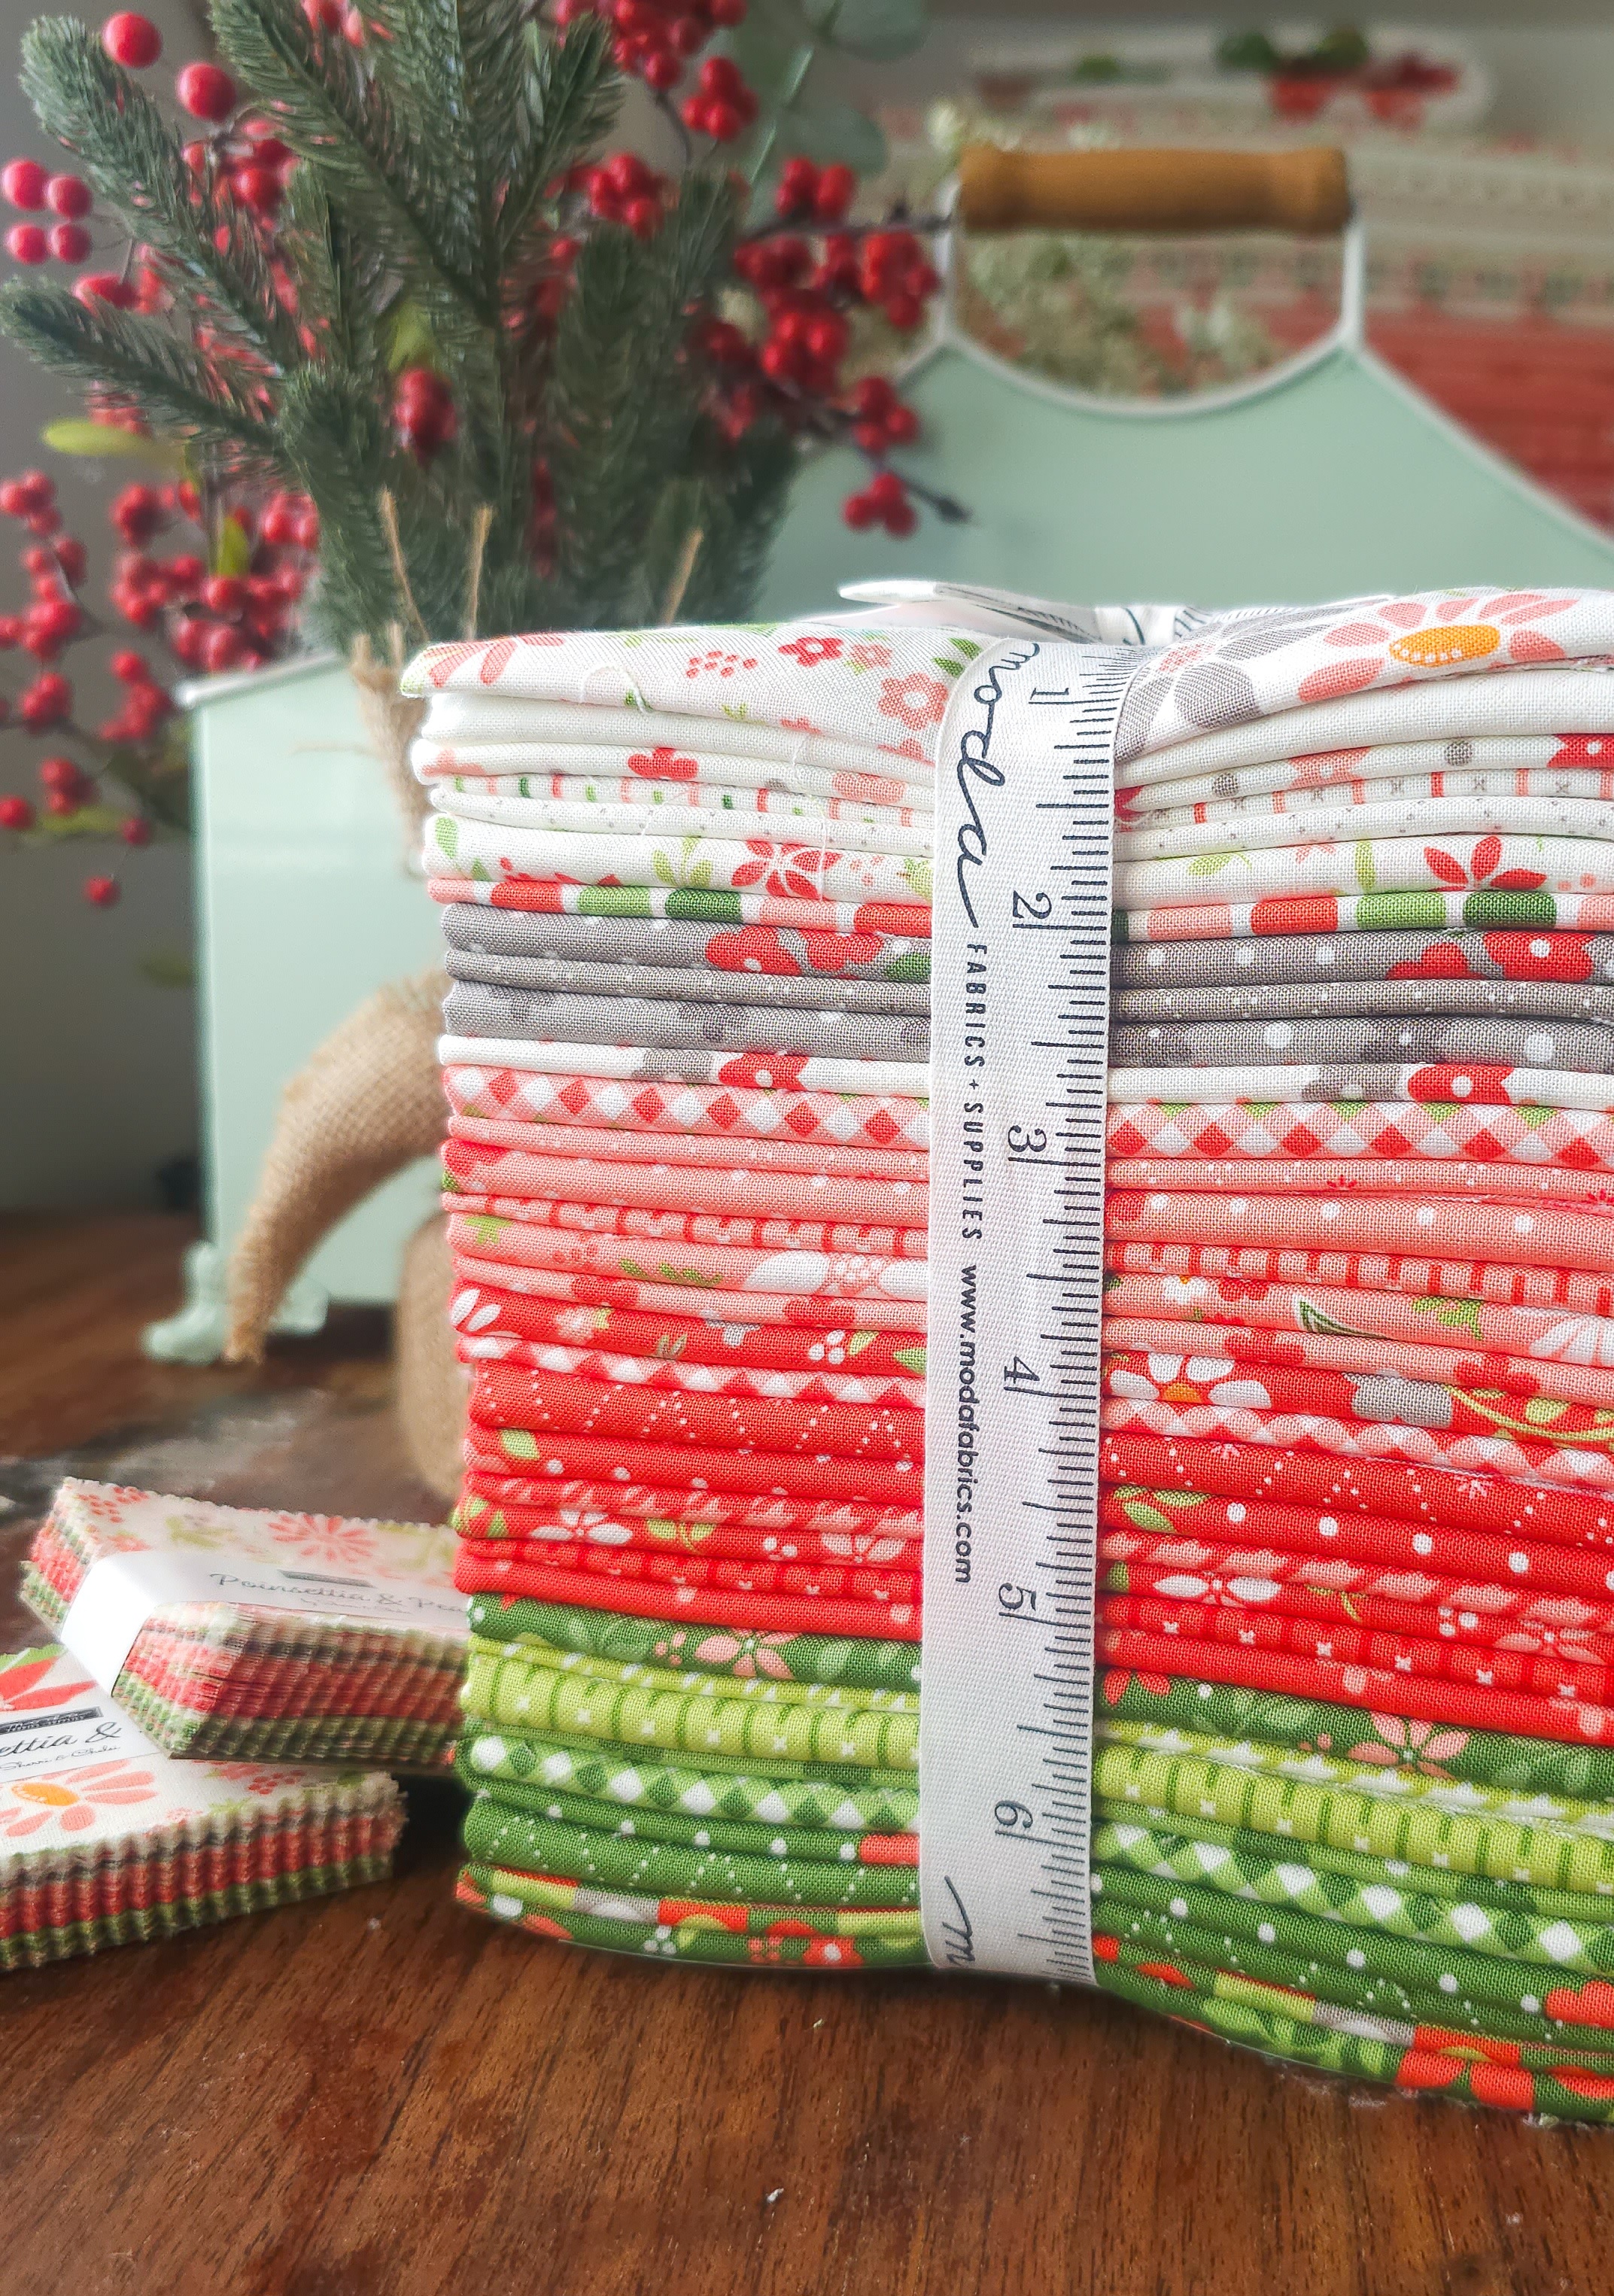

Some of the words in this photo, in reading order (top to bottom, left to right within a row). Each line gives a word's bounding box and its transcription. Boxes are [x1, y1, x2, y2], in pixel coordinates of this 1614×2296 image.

[1030, 687, 1069, 701] 1
[957, 643, 1041, 929] moda
[1013, 890, 1052, 919] 2
[965, 943, 987, 1067] FABRICS
[1008, 1125, 1047, 1152] 3
[962, 1102, 983, 1239] SUPPLIES
[1004, 1356, 1040, 1384] 4
[956, 1264, 980, 1583] www.modafabrics.com
[998, 1582, 1036, 1611] 5
[85, 1722, 122, 1743] &
[994, 1799, 1033, 1828] 6
